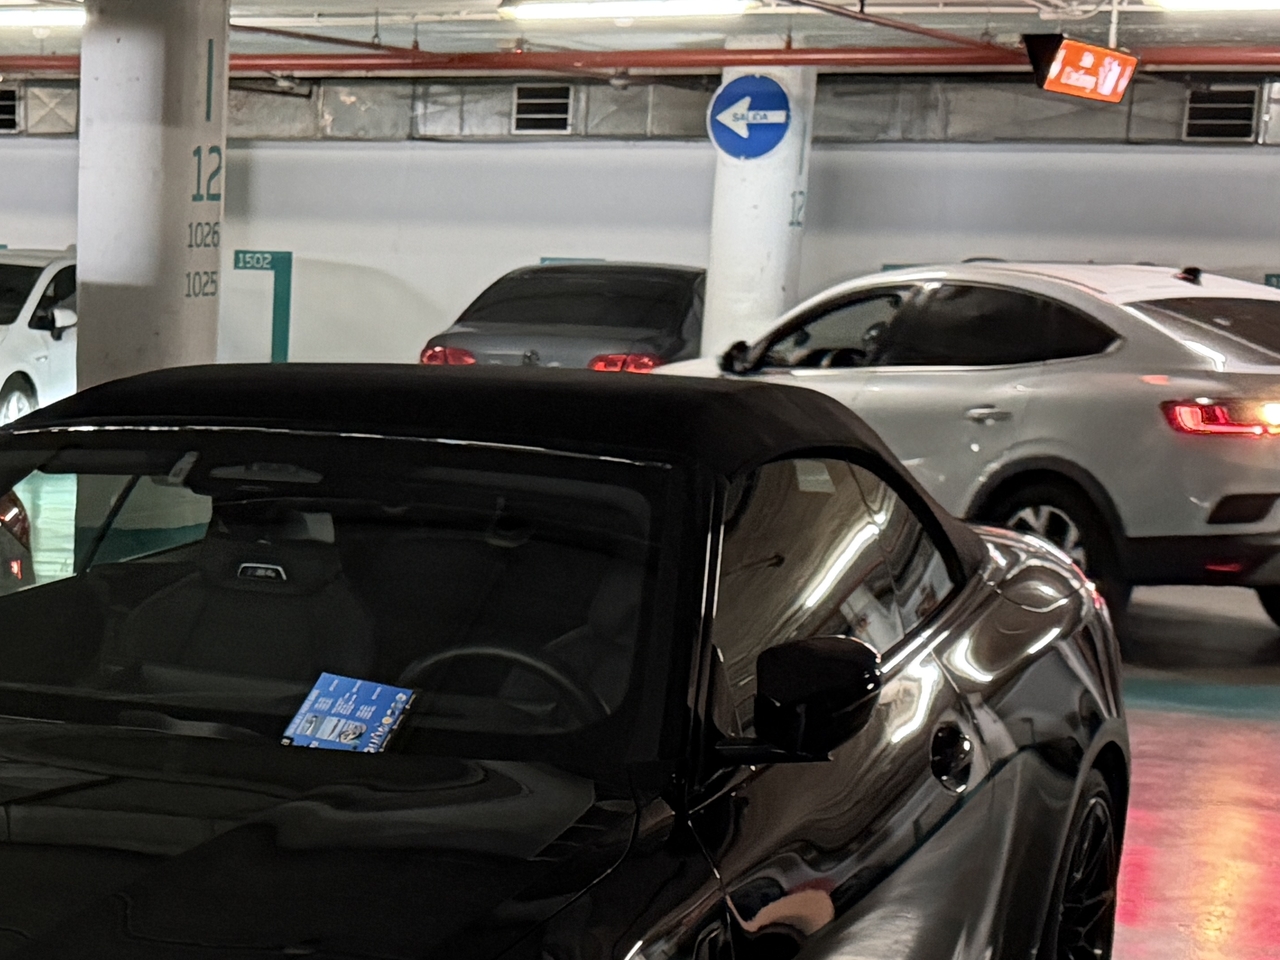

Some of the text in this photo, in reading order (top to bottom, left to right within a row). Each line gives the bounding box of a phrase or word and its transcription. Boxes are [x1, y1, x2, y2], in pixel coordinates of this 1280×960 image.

[732, 112, 769, 123] SALIDA
[191, 144, 223, 202] 12
[187, 221, 220, 249] 1026
[237, 253, 272, 268] 1502
[185, 271, 218, 298] 1025
